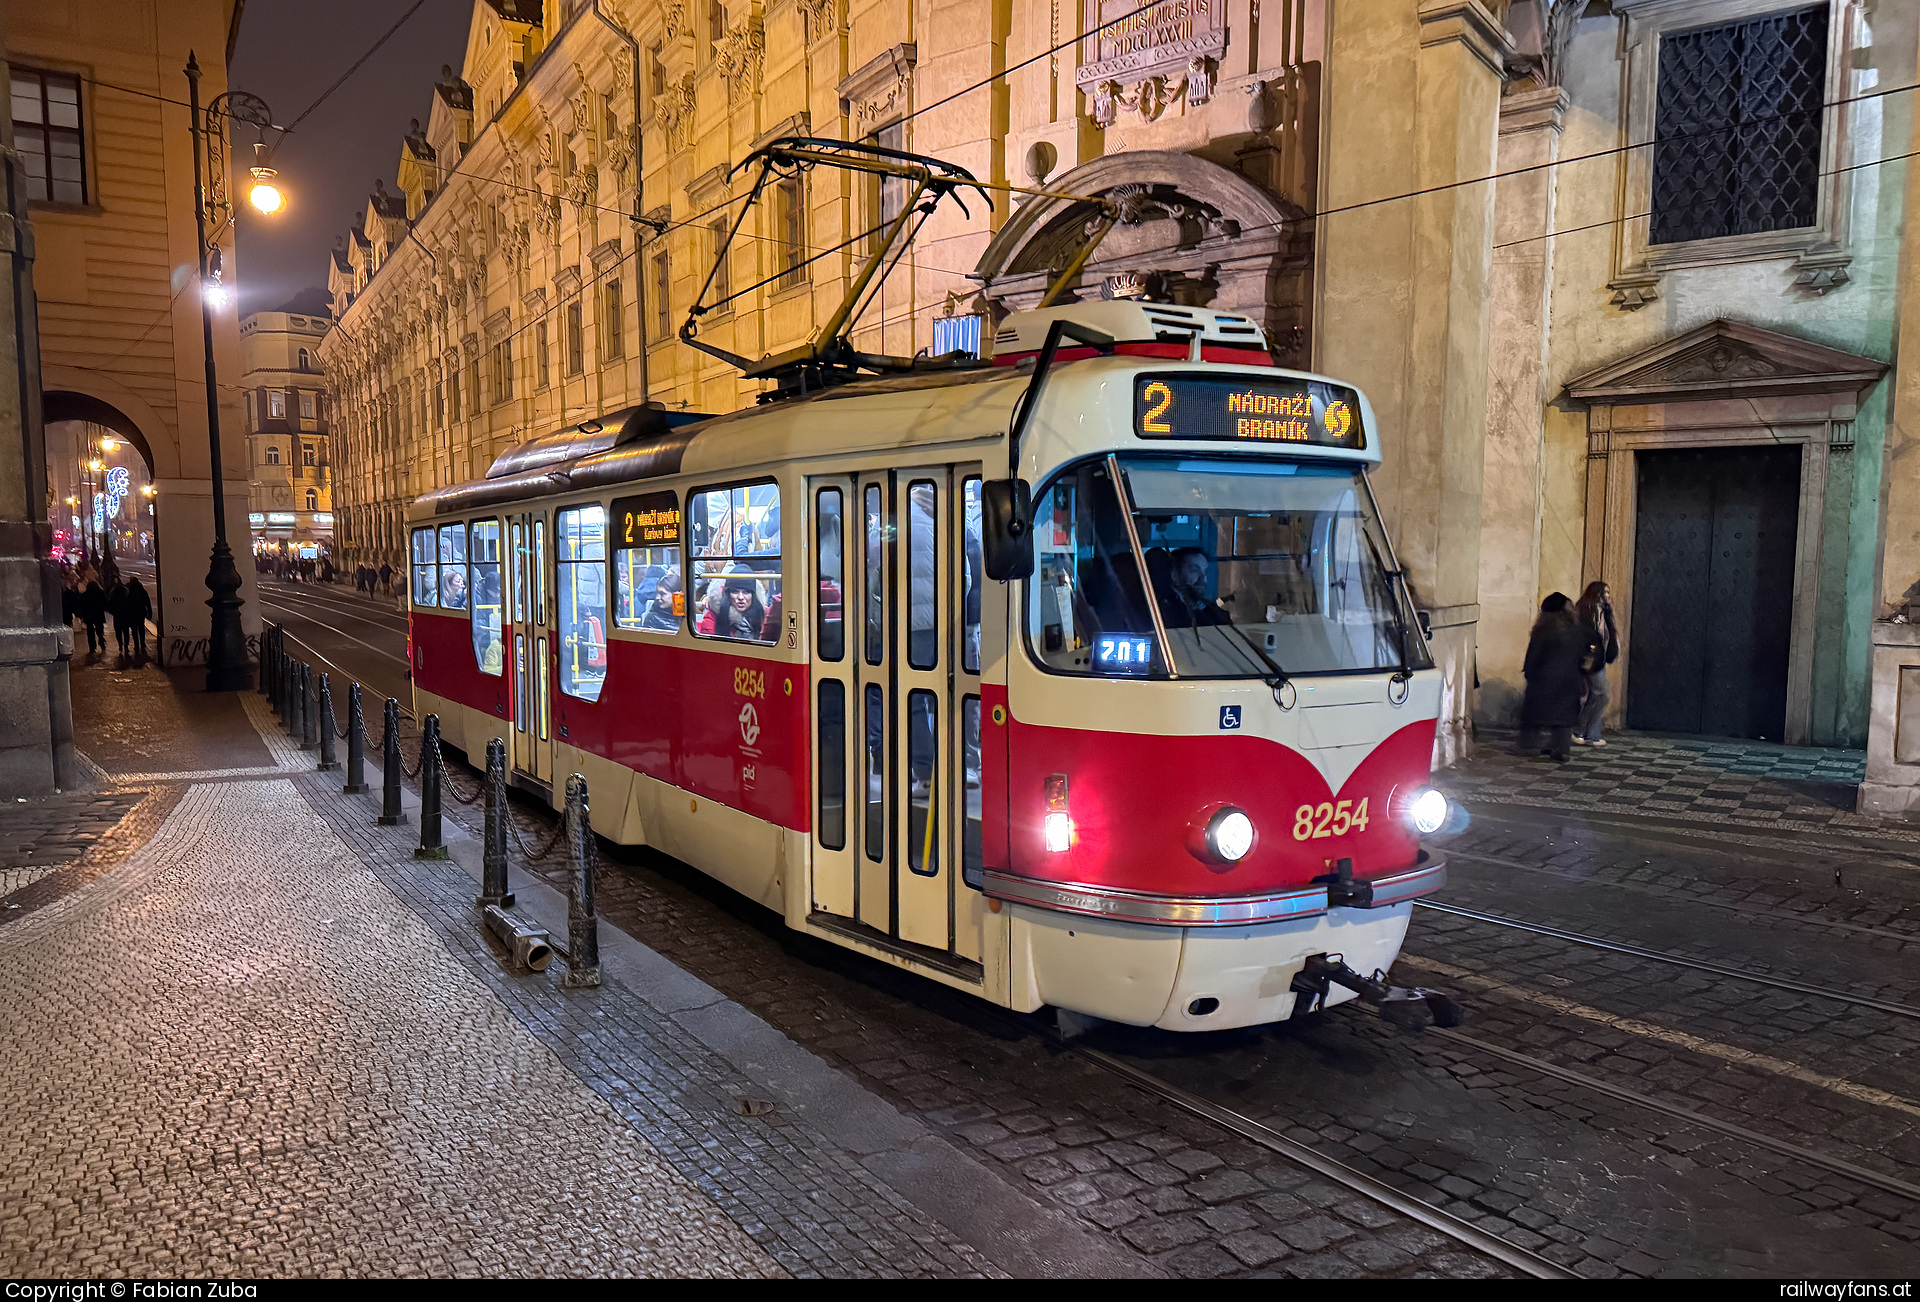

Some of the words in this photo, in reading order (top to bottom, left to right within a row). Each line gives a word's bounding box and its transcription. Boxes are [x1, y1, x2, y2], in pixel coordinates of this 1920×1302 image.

[1143, 381, 1171, 433] 2
[1228, 390, 1313, 417] NÁDRAŽÍ
[1237, 417, 1308, 441] BRANÍK
[625, 512, 634, 543] 2
[734, 667, 765, 699] 8254
[1293, 797, 1369, 841] 8254
